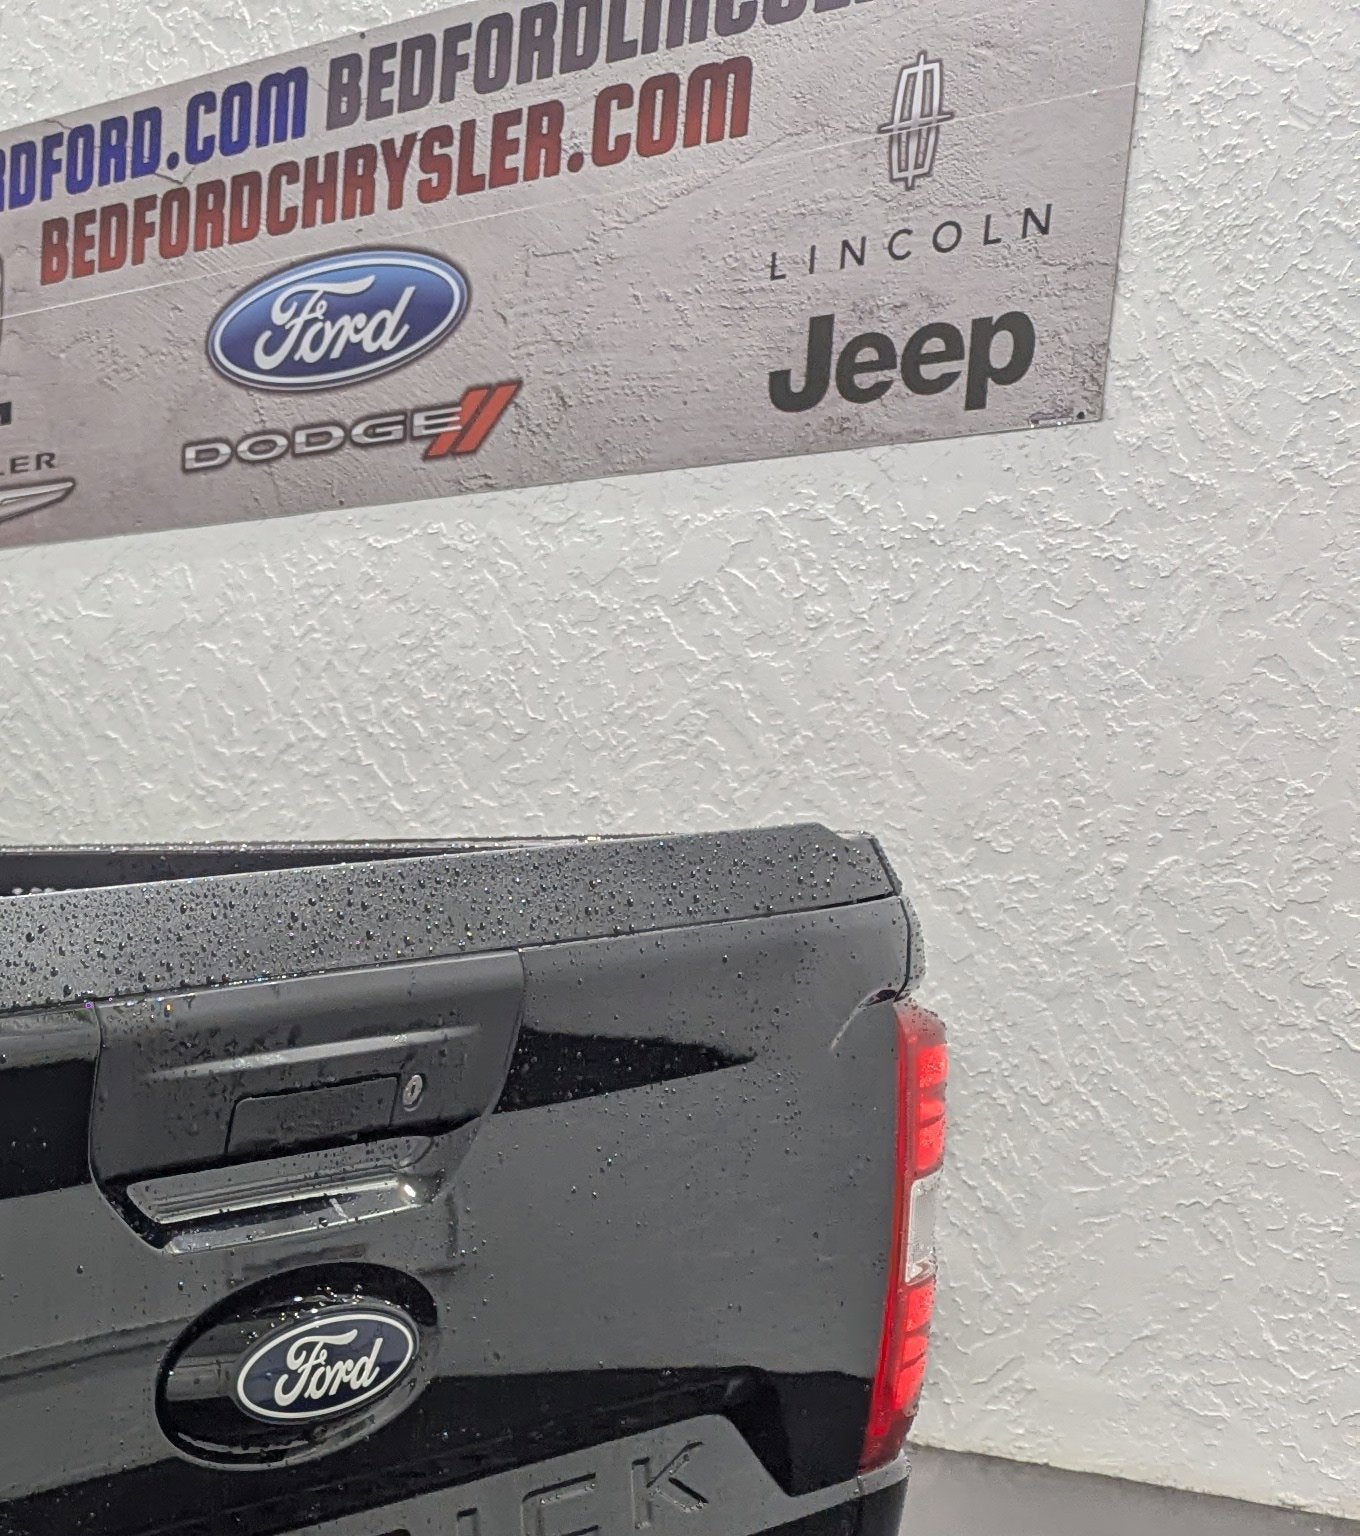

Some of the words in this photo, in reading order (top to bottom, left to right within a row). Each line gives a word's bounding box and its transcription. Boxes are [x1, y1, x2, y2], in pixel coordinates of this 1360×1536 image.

[40, 56, 753, 287] BEDFORDCHRYSLER.COM
[770, 203, 1052, 281] LINCOLN
[253, 274, 416, 370] Ford
[768, 311, 1036, 412] Jeep
[182, 404, 464, 472] DODGE
[274, 1328, 384, 1407] Ford
